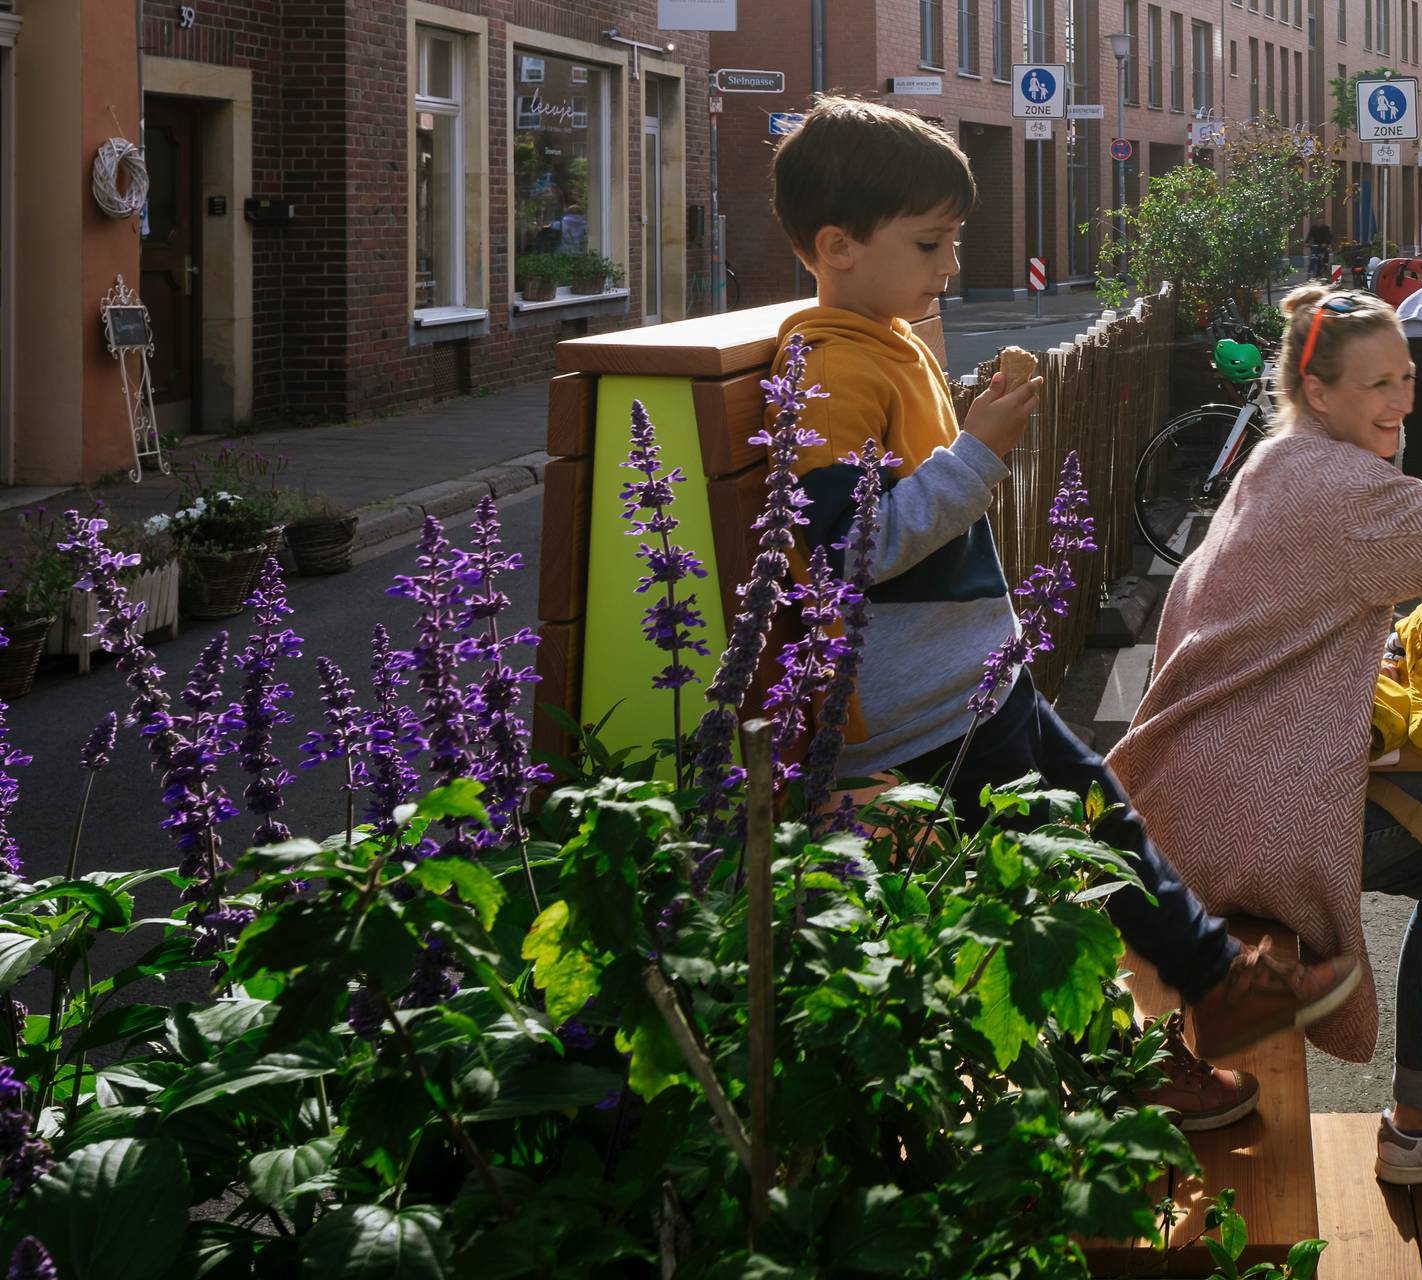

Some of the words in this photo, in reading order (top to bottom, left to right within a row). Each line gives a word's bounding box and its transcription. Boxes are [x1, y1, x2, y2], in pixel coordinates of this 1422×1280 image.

[180, 5, 195, 28] 39
[728, 76, 775, 87] Steingasse
[1025, 106, 1052, 115] ZONE
[1374, 125, 1404, 137] ZONE
